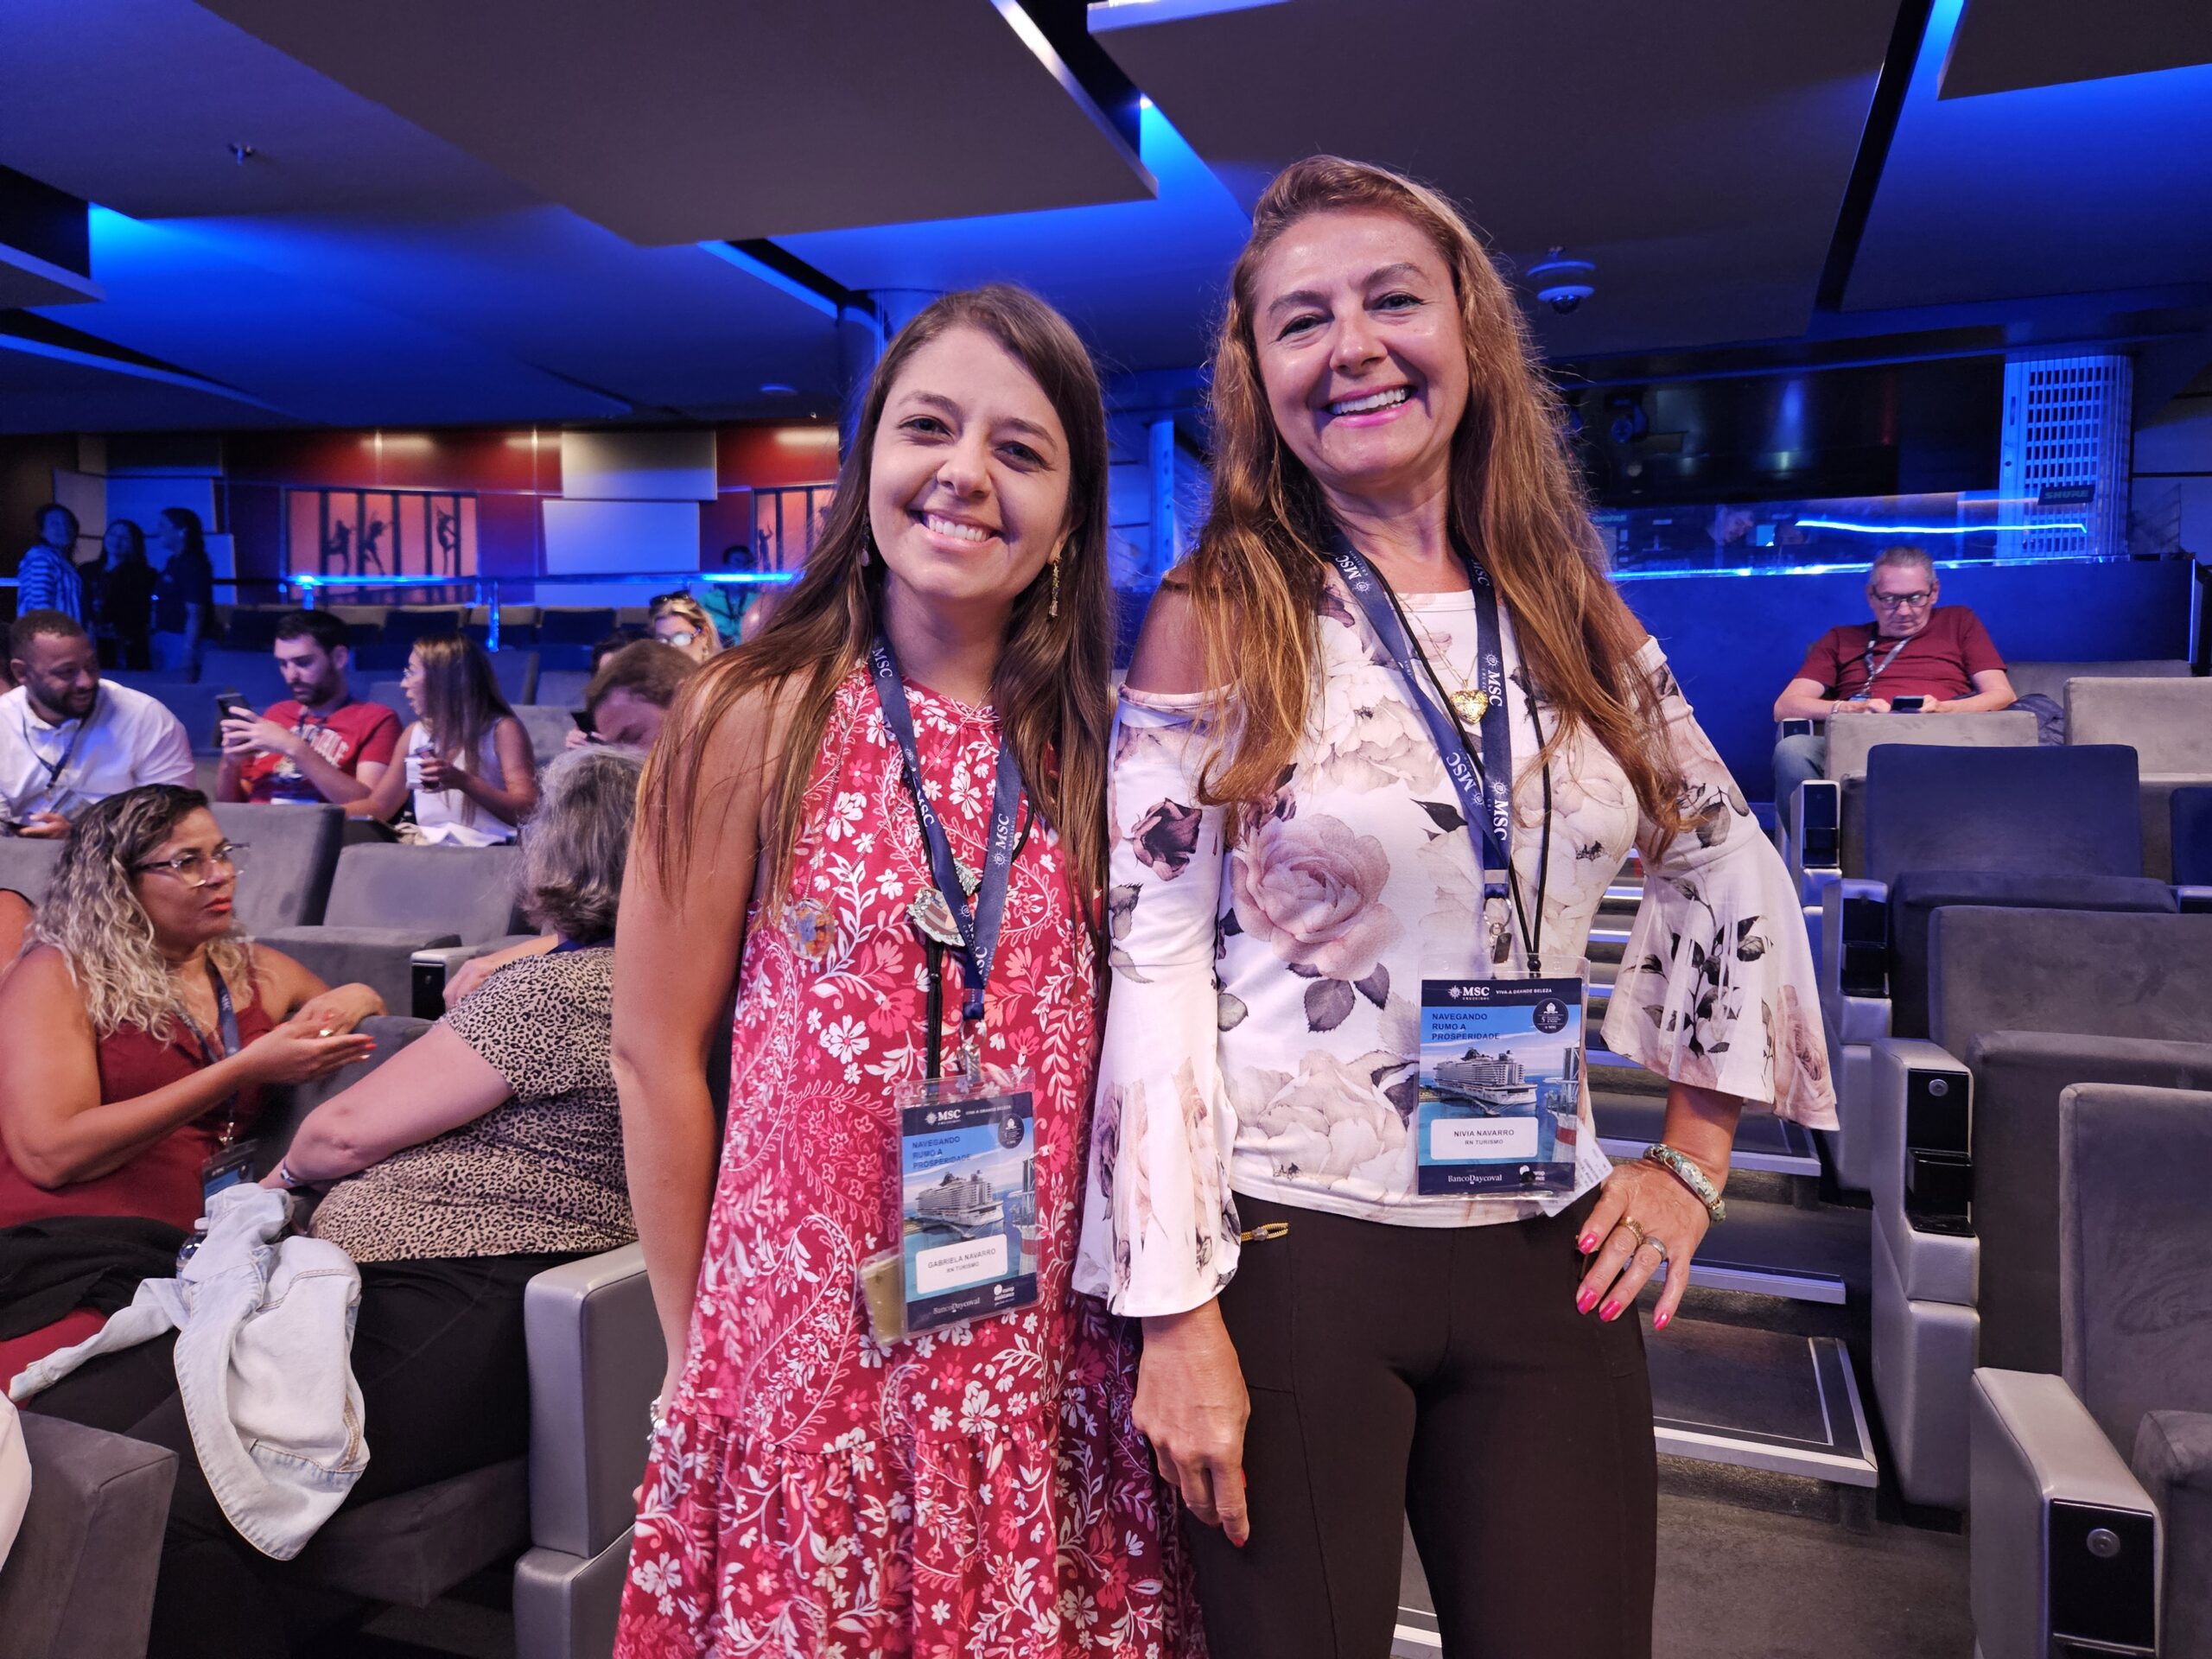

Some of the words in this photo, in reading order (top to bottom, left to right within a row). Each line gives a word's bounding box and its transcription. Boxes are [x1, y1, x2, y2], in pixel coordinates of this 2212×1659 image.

[2044, 490, 2089, 499] SHURE
[1335, 555, 1363, 582] MSC
[871, 646, 893, 678] MSC
[1488, 670, 1503, 707] MSC
[1446, 752, 1478, 793] MSC
[1493, 798, 1510, 841] MSC
[995, 813, 1010, 851] MSC
[1463, 986, 1491, 996] MSC
[937, 1109, 962, 1121] MSC
[1453, 1129, 1475, 1138] NIVIA
[1476, 1128, 1515, 1137] NAVARRO
[912, 1136, 961, 1148] NAVEGANDO
[912, 1154, 970, 1169] PROSPERIDADE
[1447, 1174, 1503, 1184] BancoDaycoval
[928, 1255, 963, 1268] GABRIELA
[963, 1248, 996, 1261] NAVARRO
